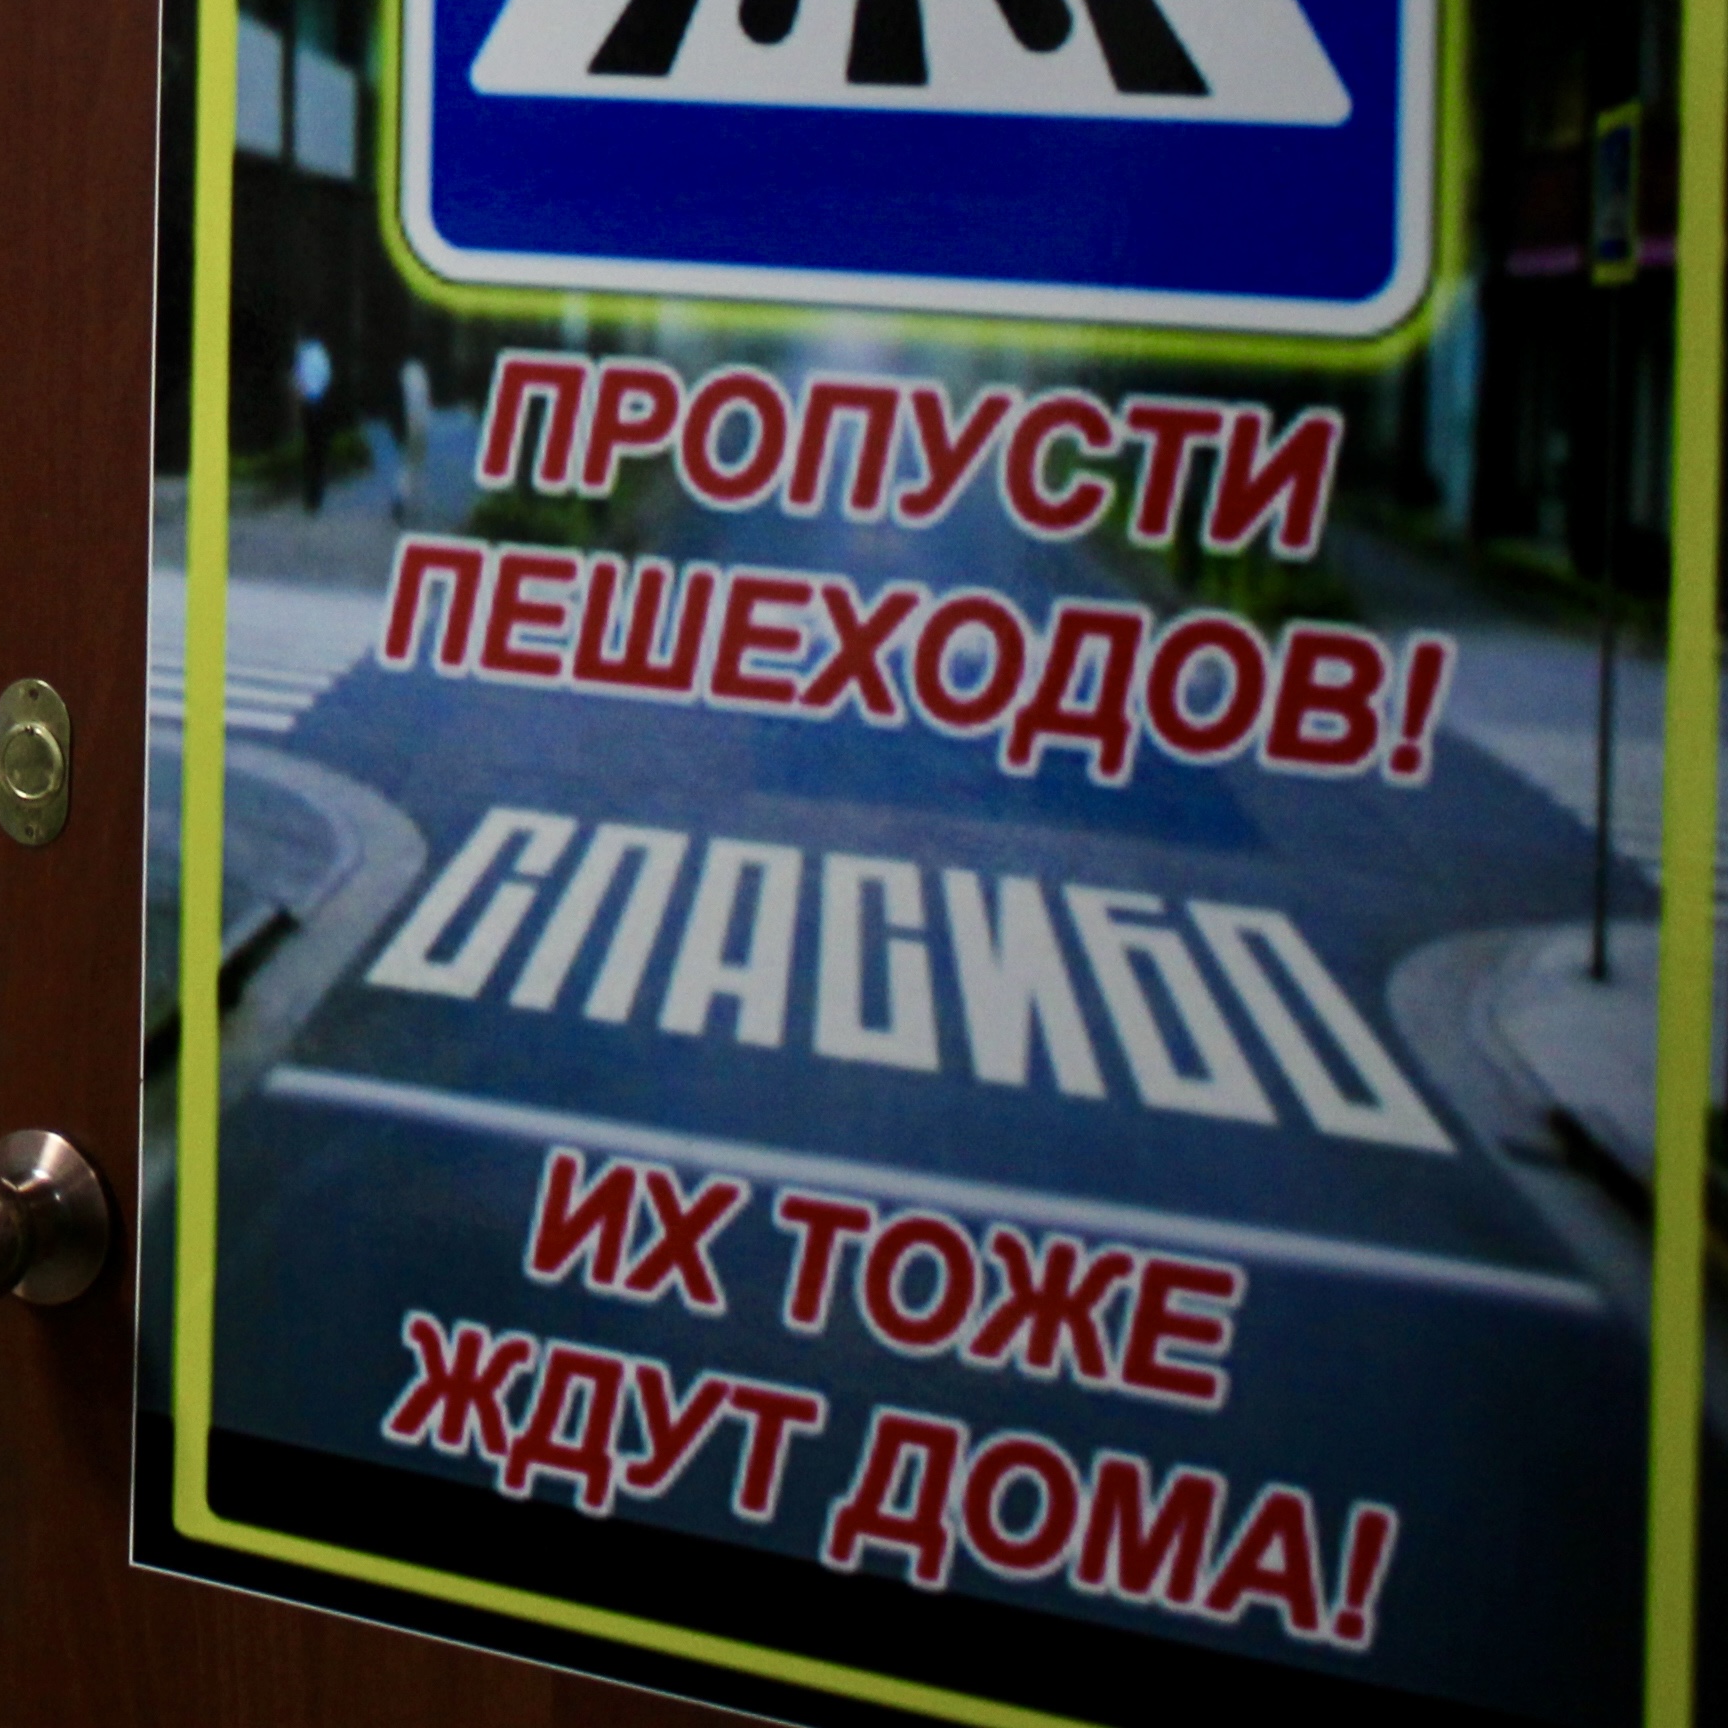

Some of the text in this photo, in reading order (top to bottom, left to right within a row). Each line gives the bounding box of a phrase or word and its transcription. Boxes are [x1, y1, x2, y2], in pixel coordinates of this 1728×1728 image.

[481, 358, 1338, 553] ПРОПУСТИ
[383, 543, 1450, 778] ПЕШЕХОДОВ!
[367, 807, 1461, 1154] СПАСИБО
[528, 1155, 1243, 1404] ИХ ТОЖЕ
[390, 1316, 1393, 1646] ЖДУТ ДОМА!
